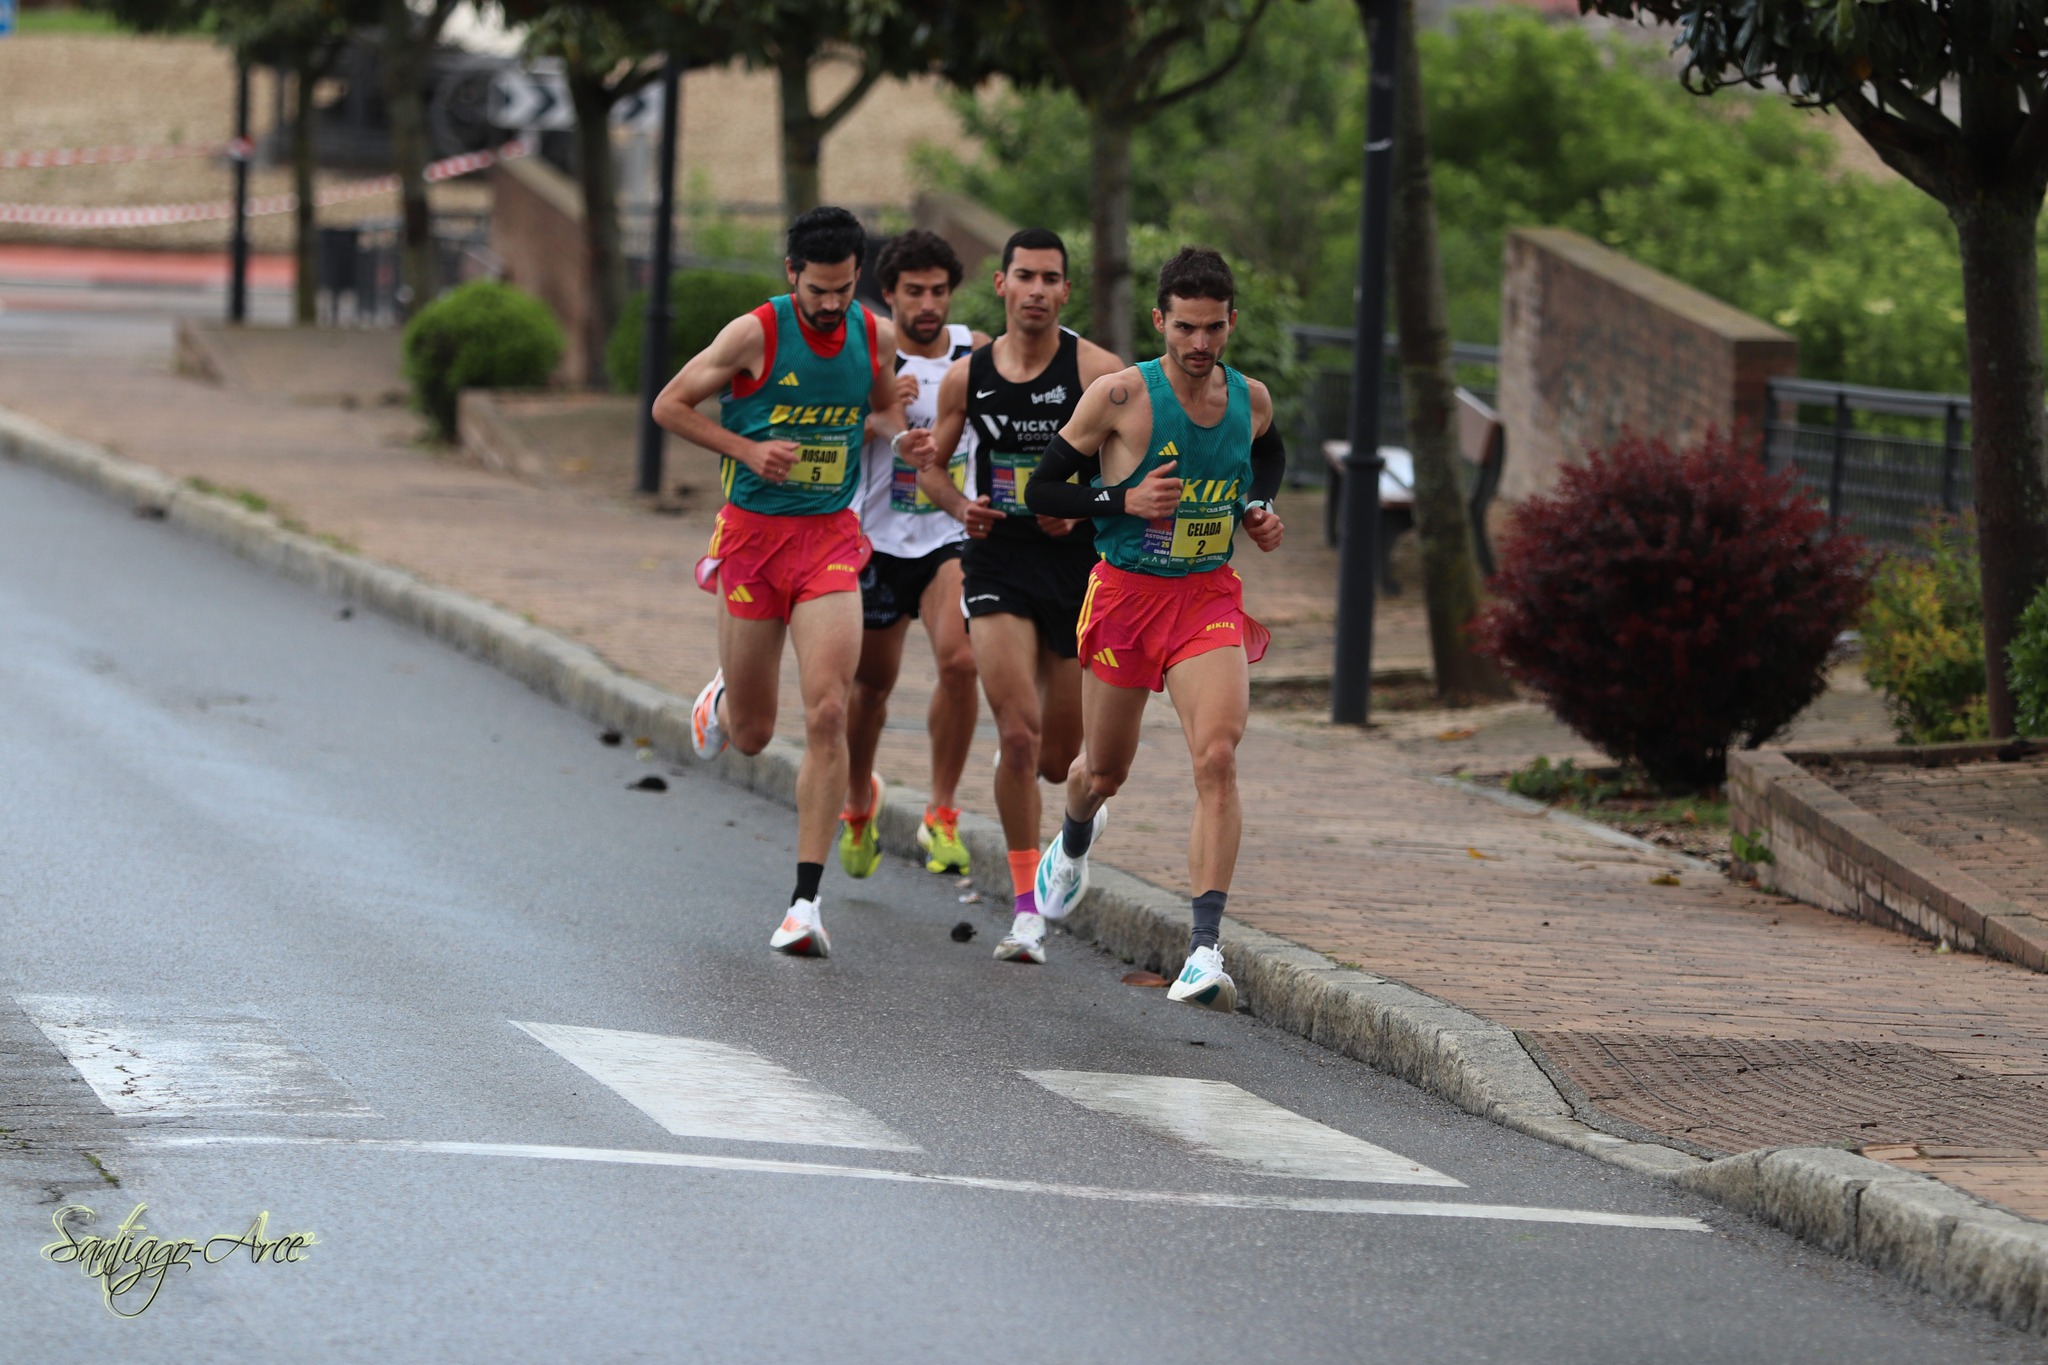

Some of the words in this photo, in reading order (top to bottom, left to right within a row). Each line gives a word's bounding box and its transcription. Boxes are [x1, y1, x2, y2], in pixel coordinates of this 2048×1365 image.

[1012, 420, 1059, 433] VICKY
[801, 449, 838, 464] ROSADO
[811, 467, 821, 482] 5
[1187, 522, 1221, 537] CELADA
[1196, 540, 1206, 555] 2
[1205, 621, 1236, 632] BIKILA
